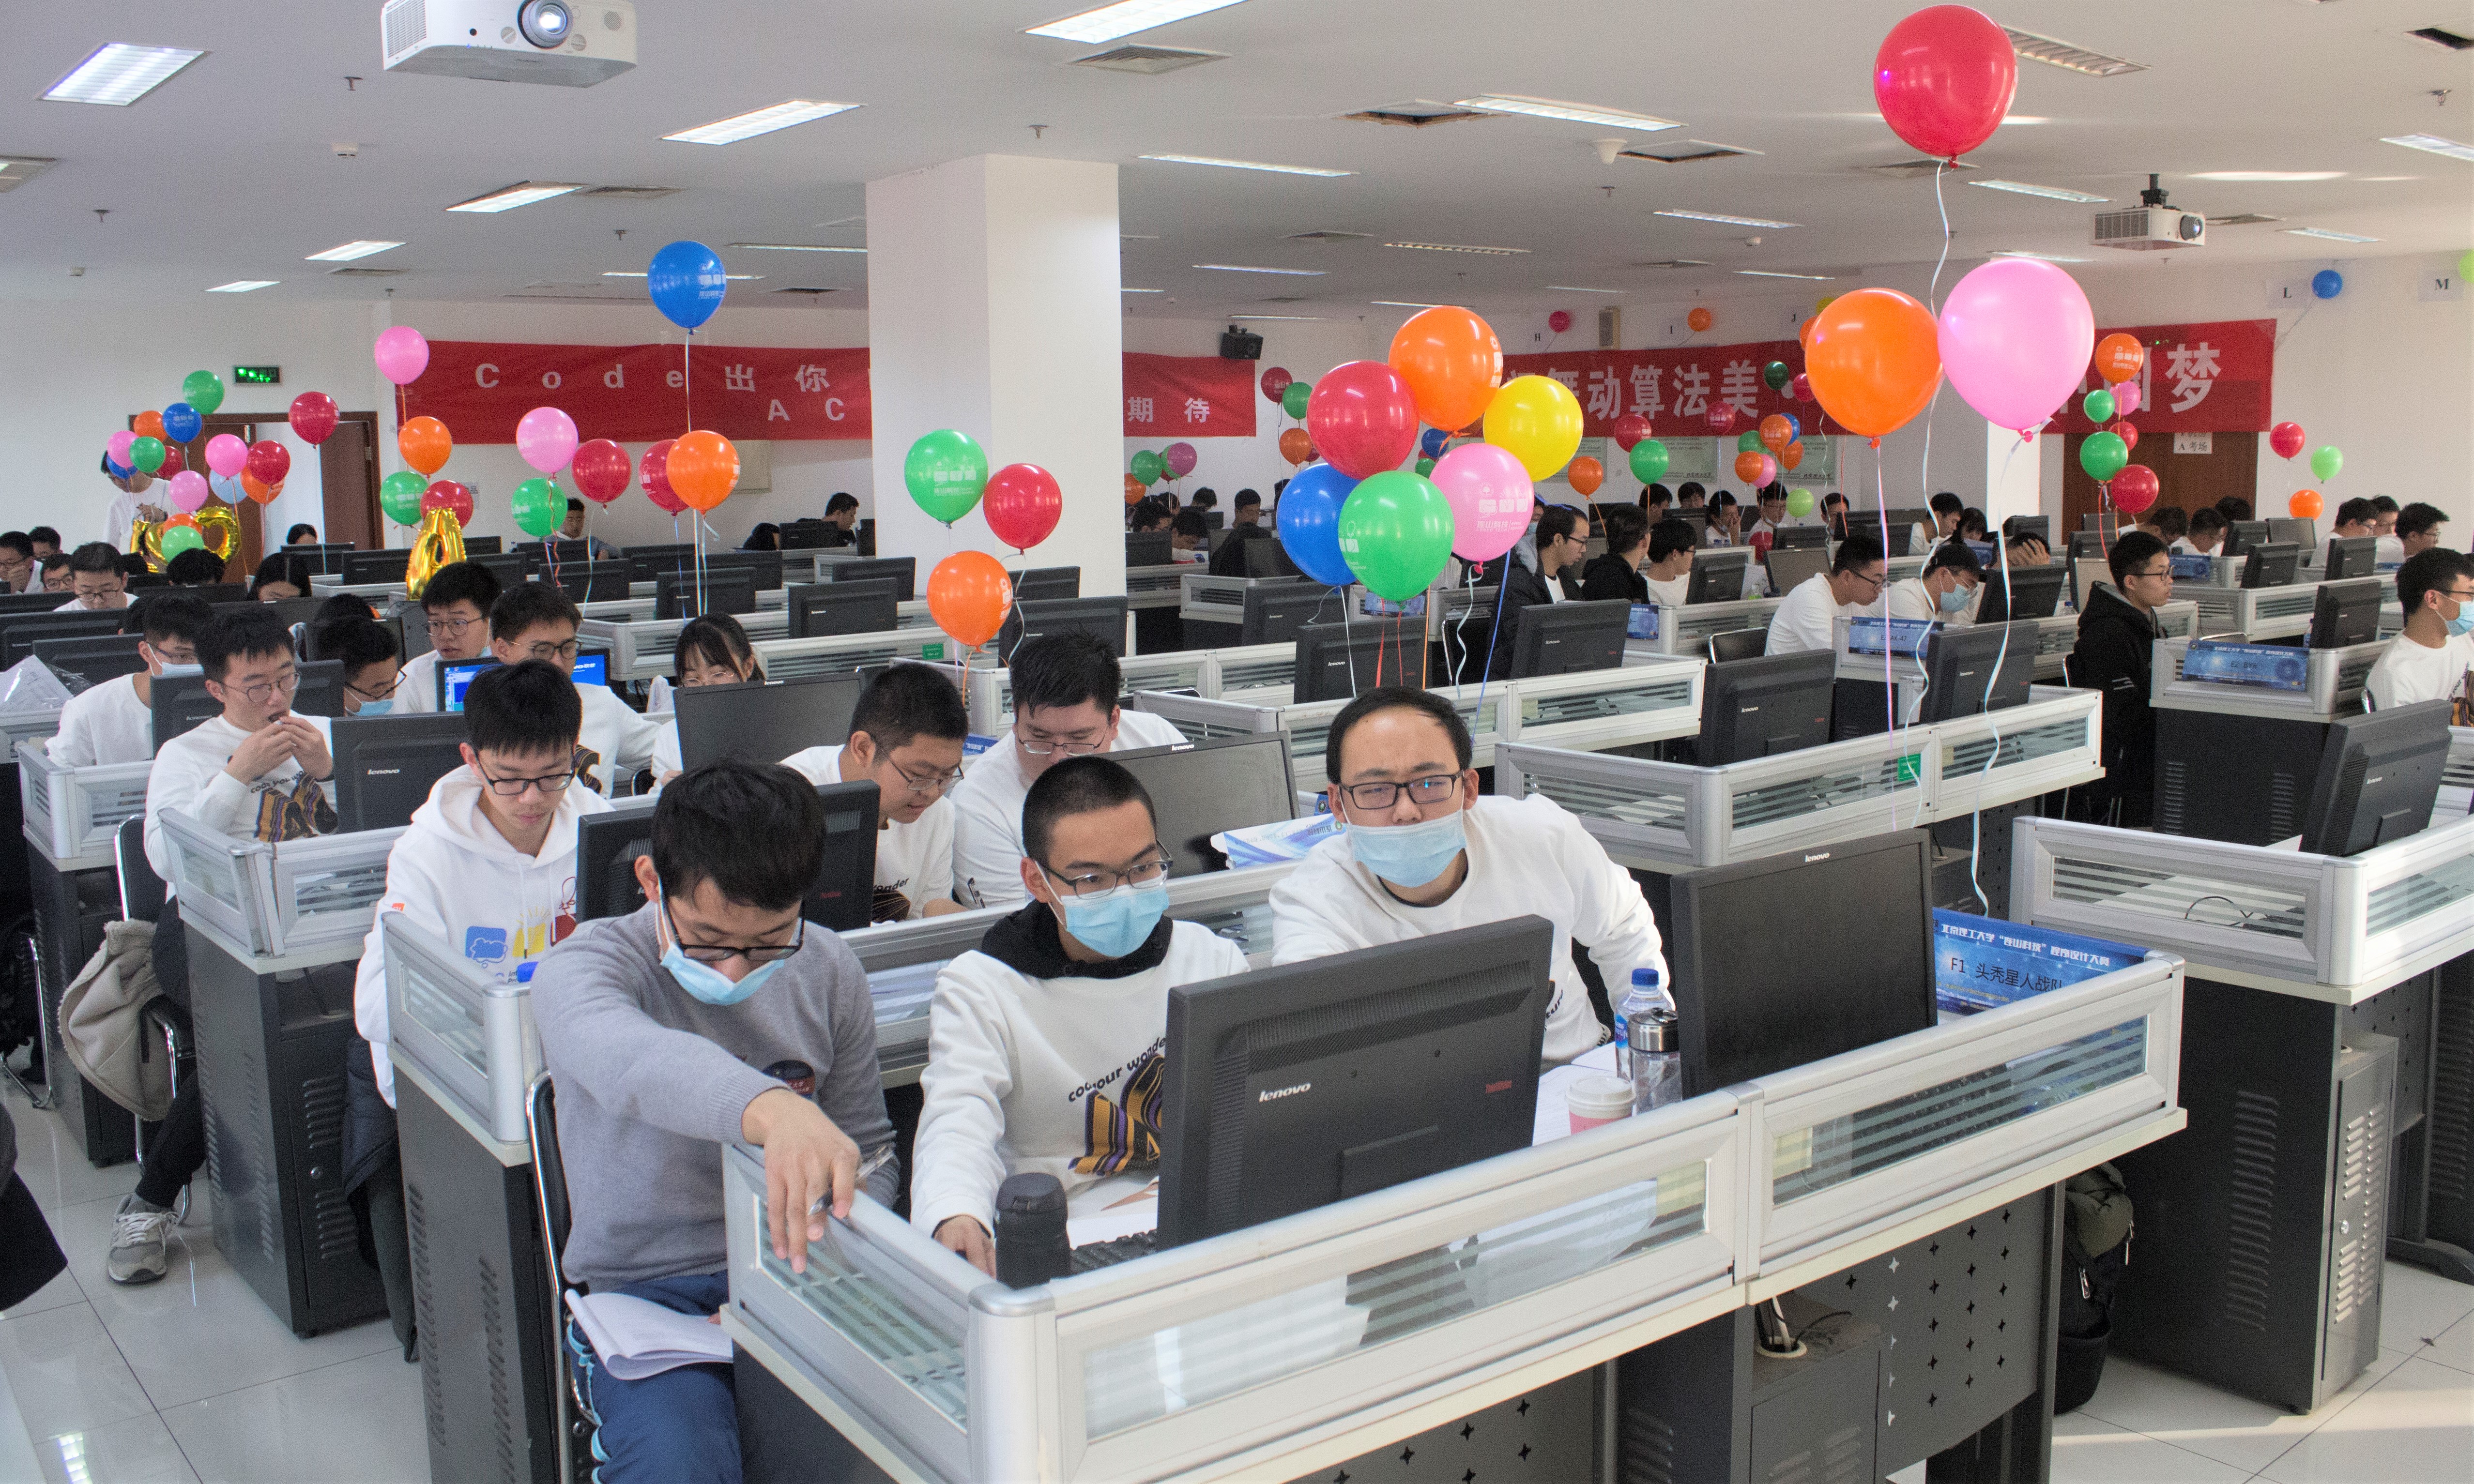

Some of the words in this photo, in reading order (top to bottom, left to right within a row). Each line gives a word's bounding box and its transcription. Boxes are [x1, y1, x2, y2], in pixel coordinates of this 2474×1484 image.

[2435, 278, 2448, 290] M
[2283, 288, 2292, 298] L
[1127, 396, 1210, 423] 期待
[1805, 853, 1830, 863] lenovo
[1936, 957, 1951, 973] F1
[1126, 1037, 1166, 1071] wonde
[1258, 1082, 1311, 1103] lenovo
